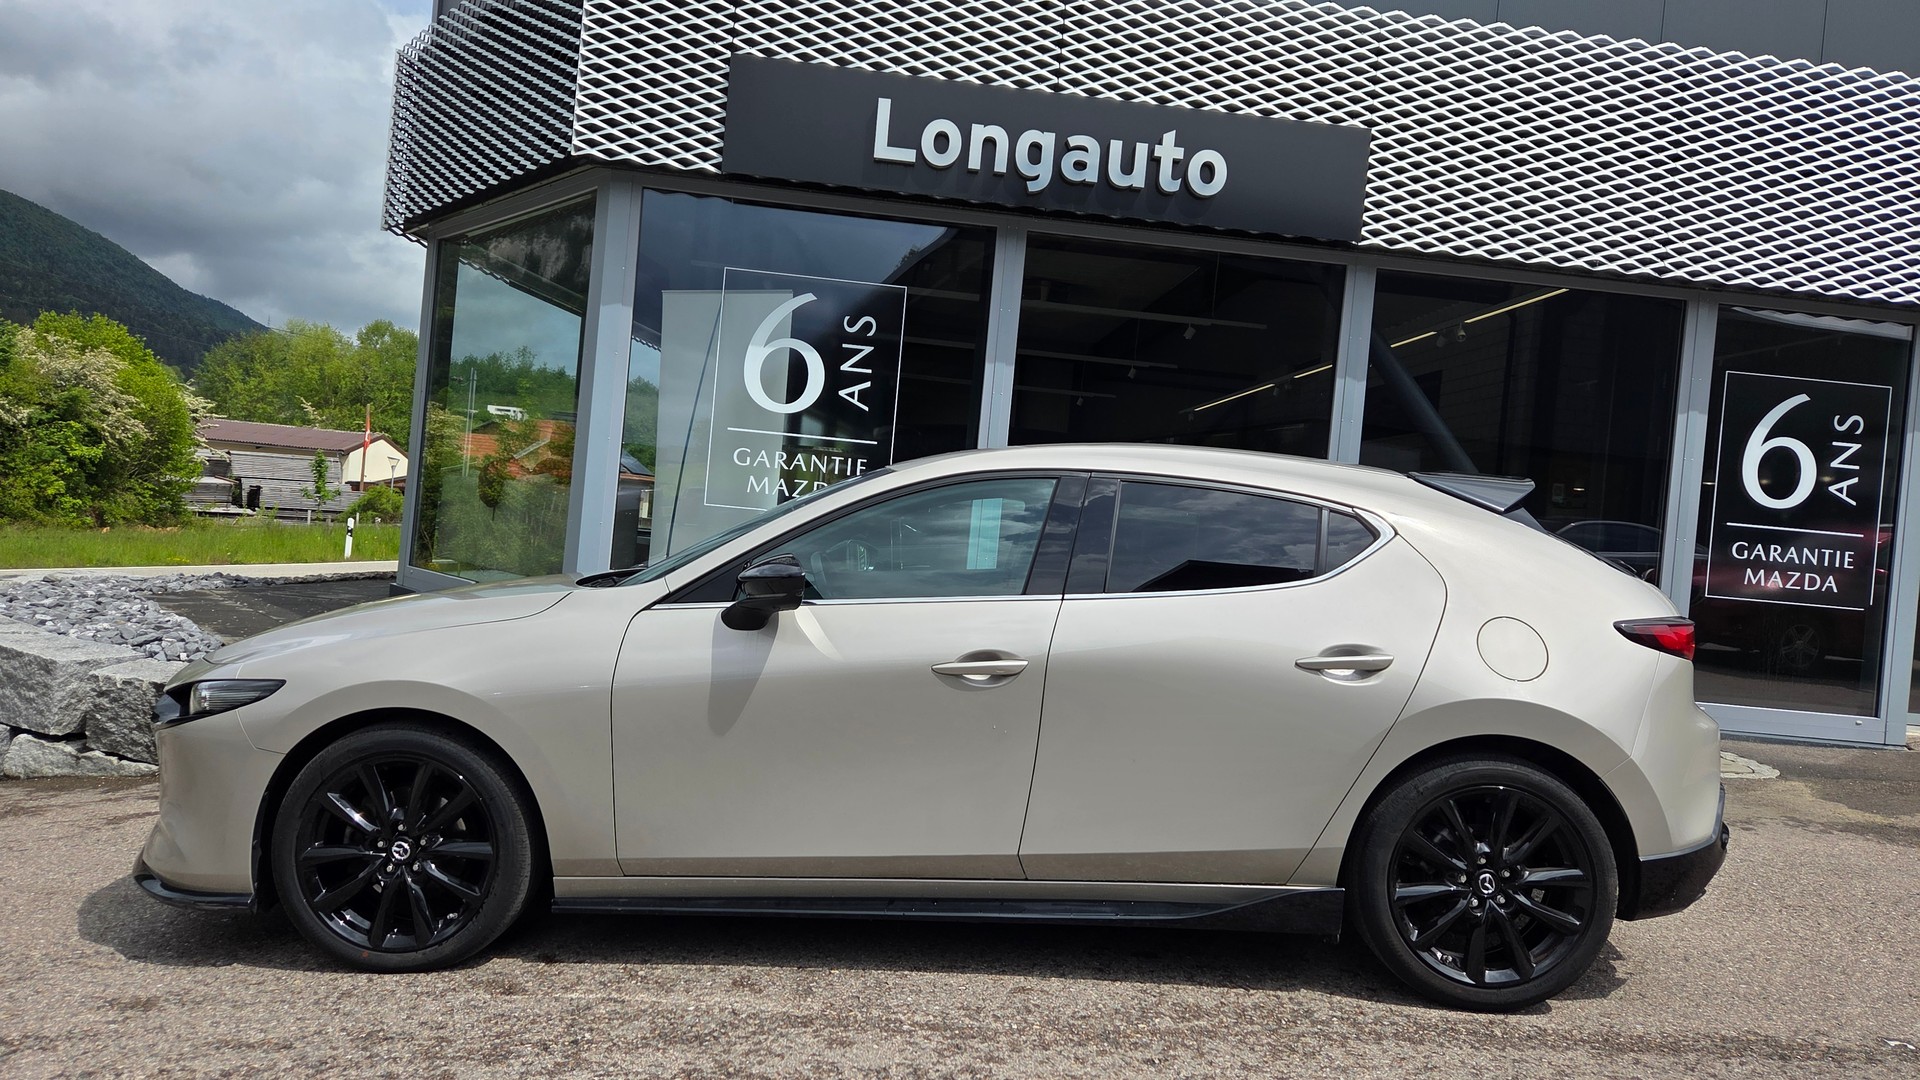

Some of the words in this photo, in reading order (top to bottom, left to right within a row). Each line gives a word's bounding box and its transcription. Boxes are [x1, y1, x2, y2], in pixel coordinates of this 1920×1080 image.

[873, 97, 1228, 197] Longauto
[744, 292, 825, 414] 6
[838, 315, 876, 411] ANS
[1742, 393, 1817, 509] 6
[1828, 414, 1865, 506] ANS
[1731, 541, 1855, 569] GARANTIE
[1743, 567, 1838, 593] MAZDA
